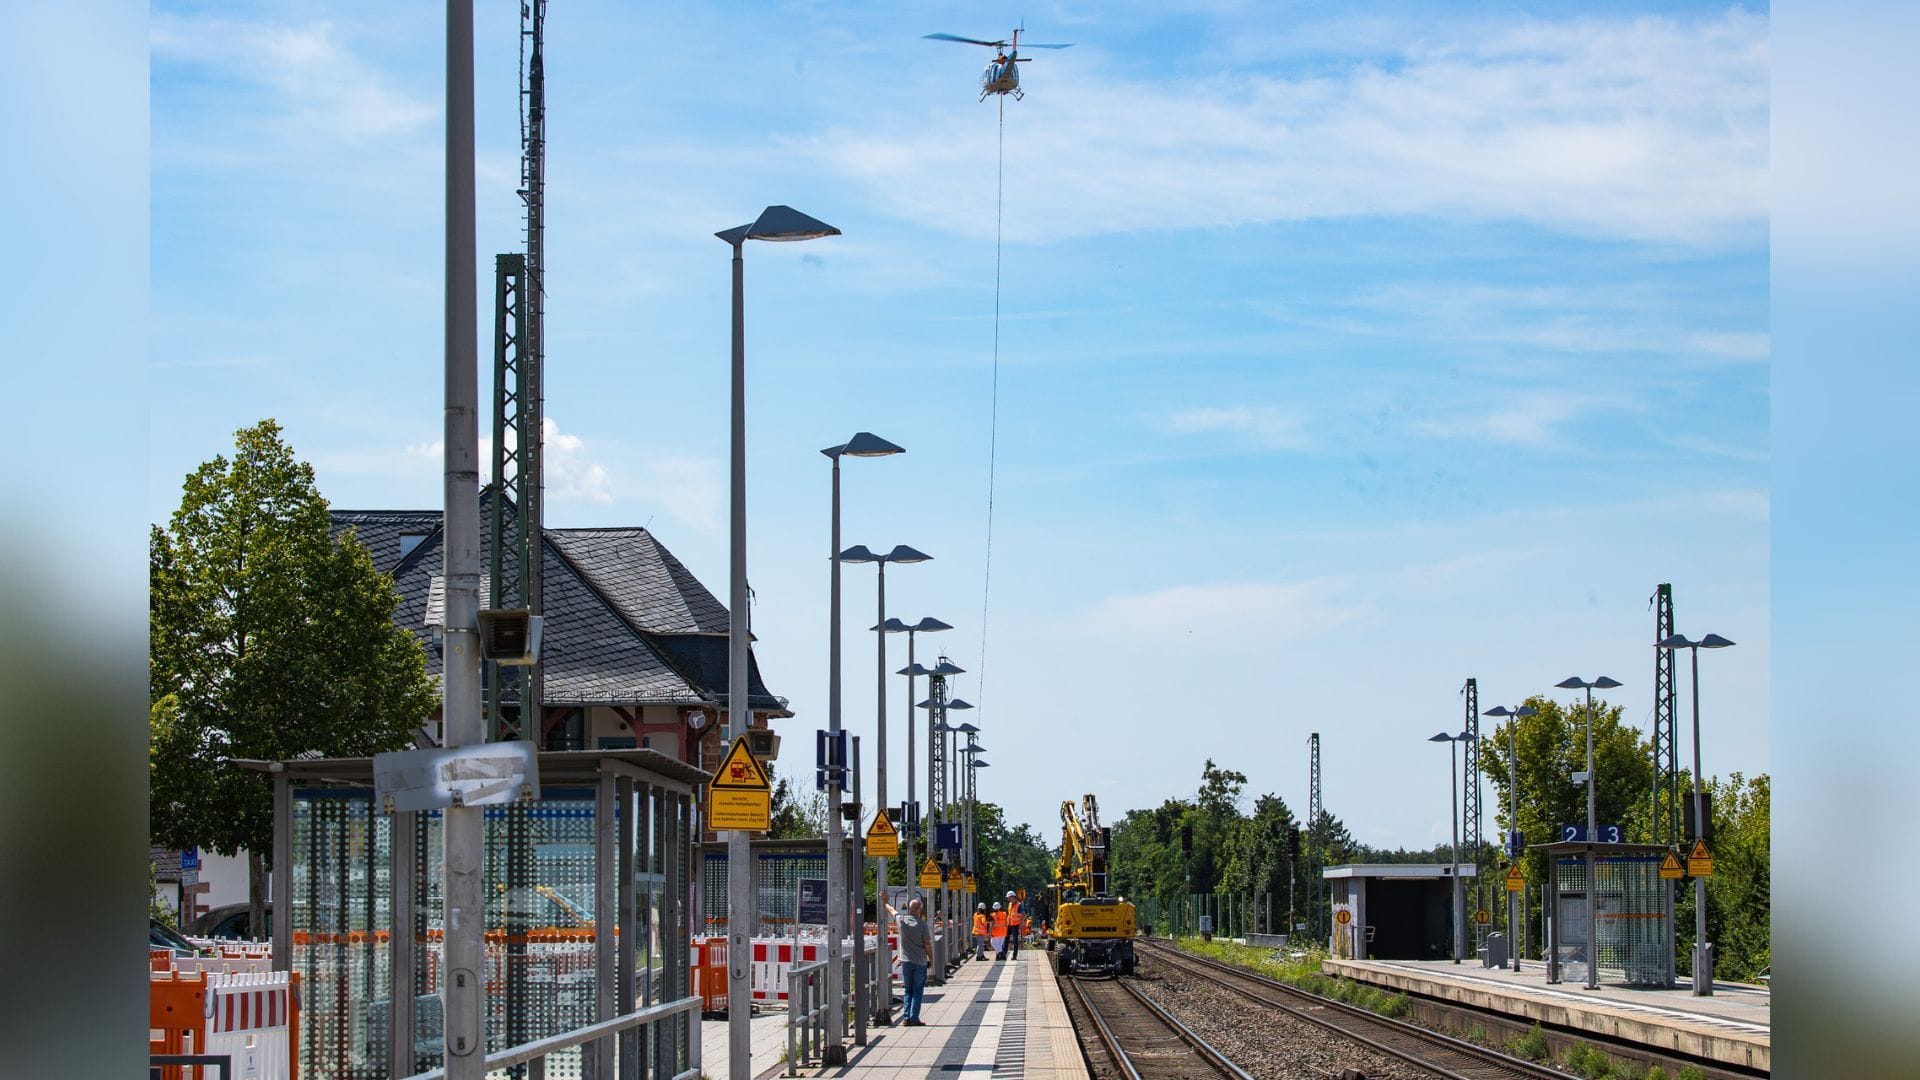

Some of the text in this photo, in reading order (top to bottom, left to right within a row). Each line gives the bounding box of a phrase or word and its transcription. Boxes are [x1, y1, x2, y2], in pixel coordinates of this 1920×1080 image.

[951, 825, 959, 843] 1
[1565, 826, 1577, 842] 2
[1607, 826, 1620, 844] 3
